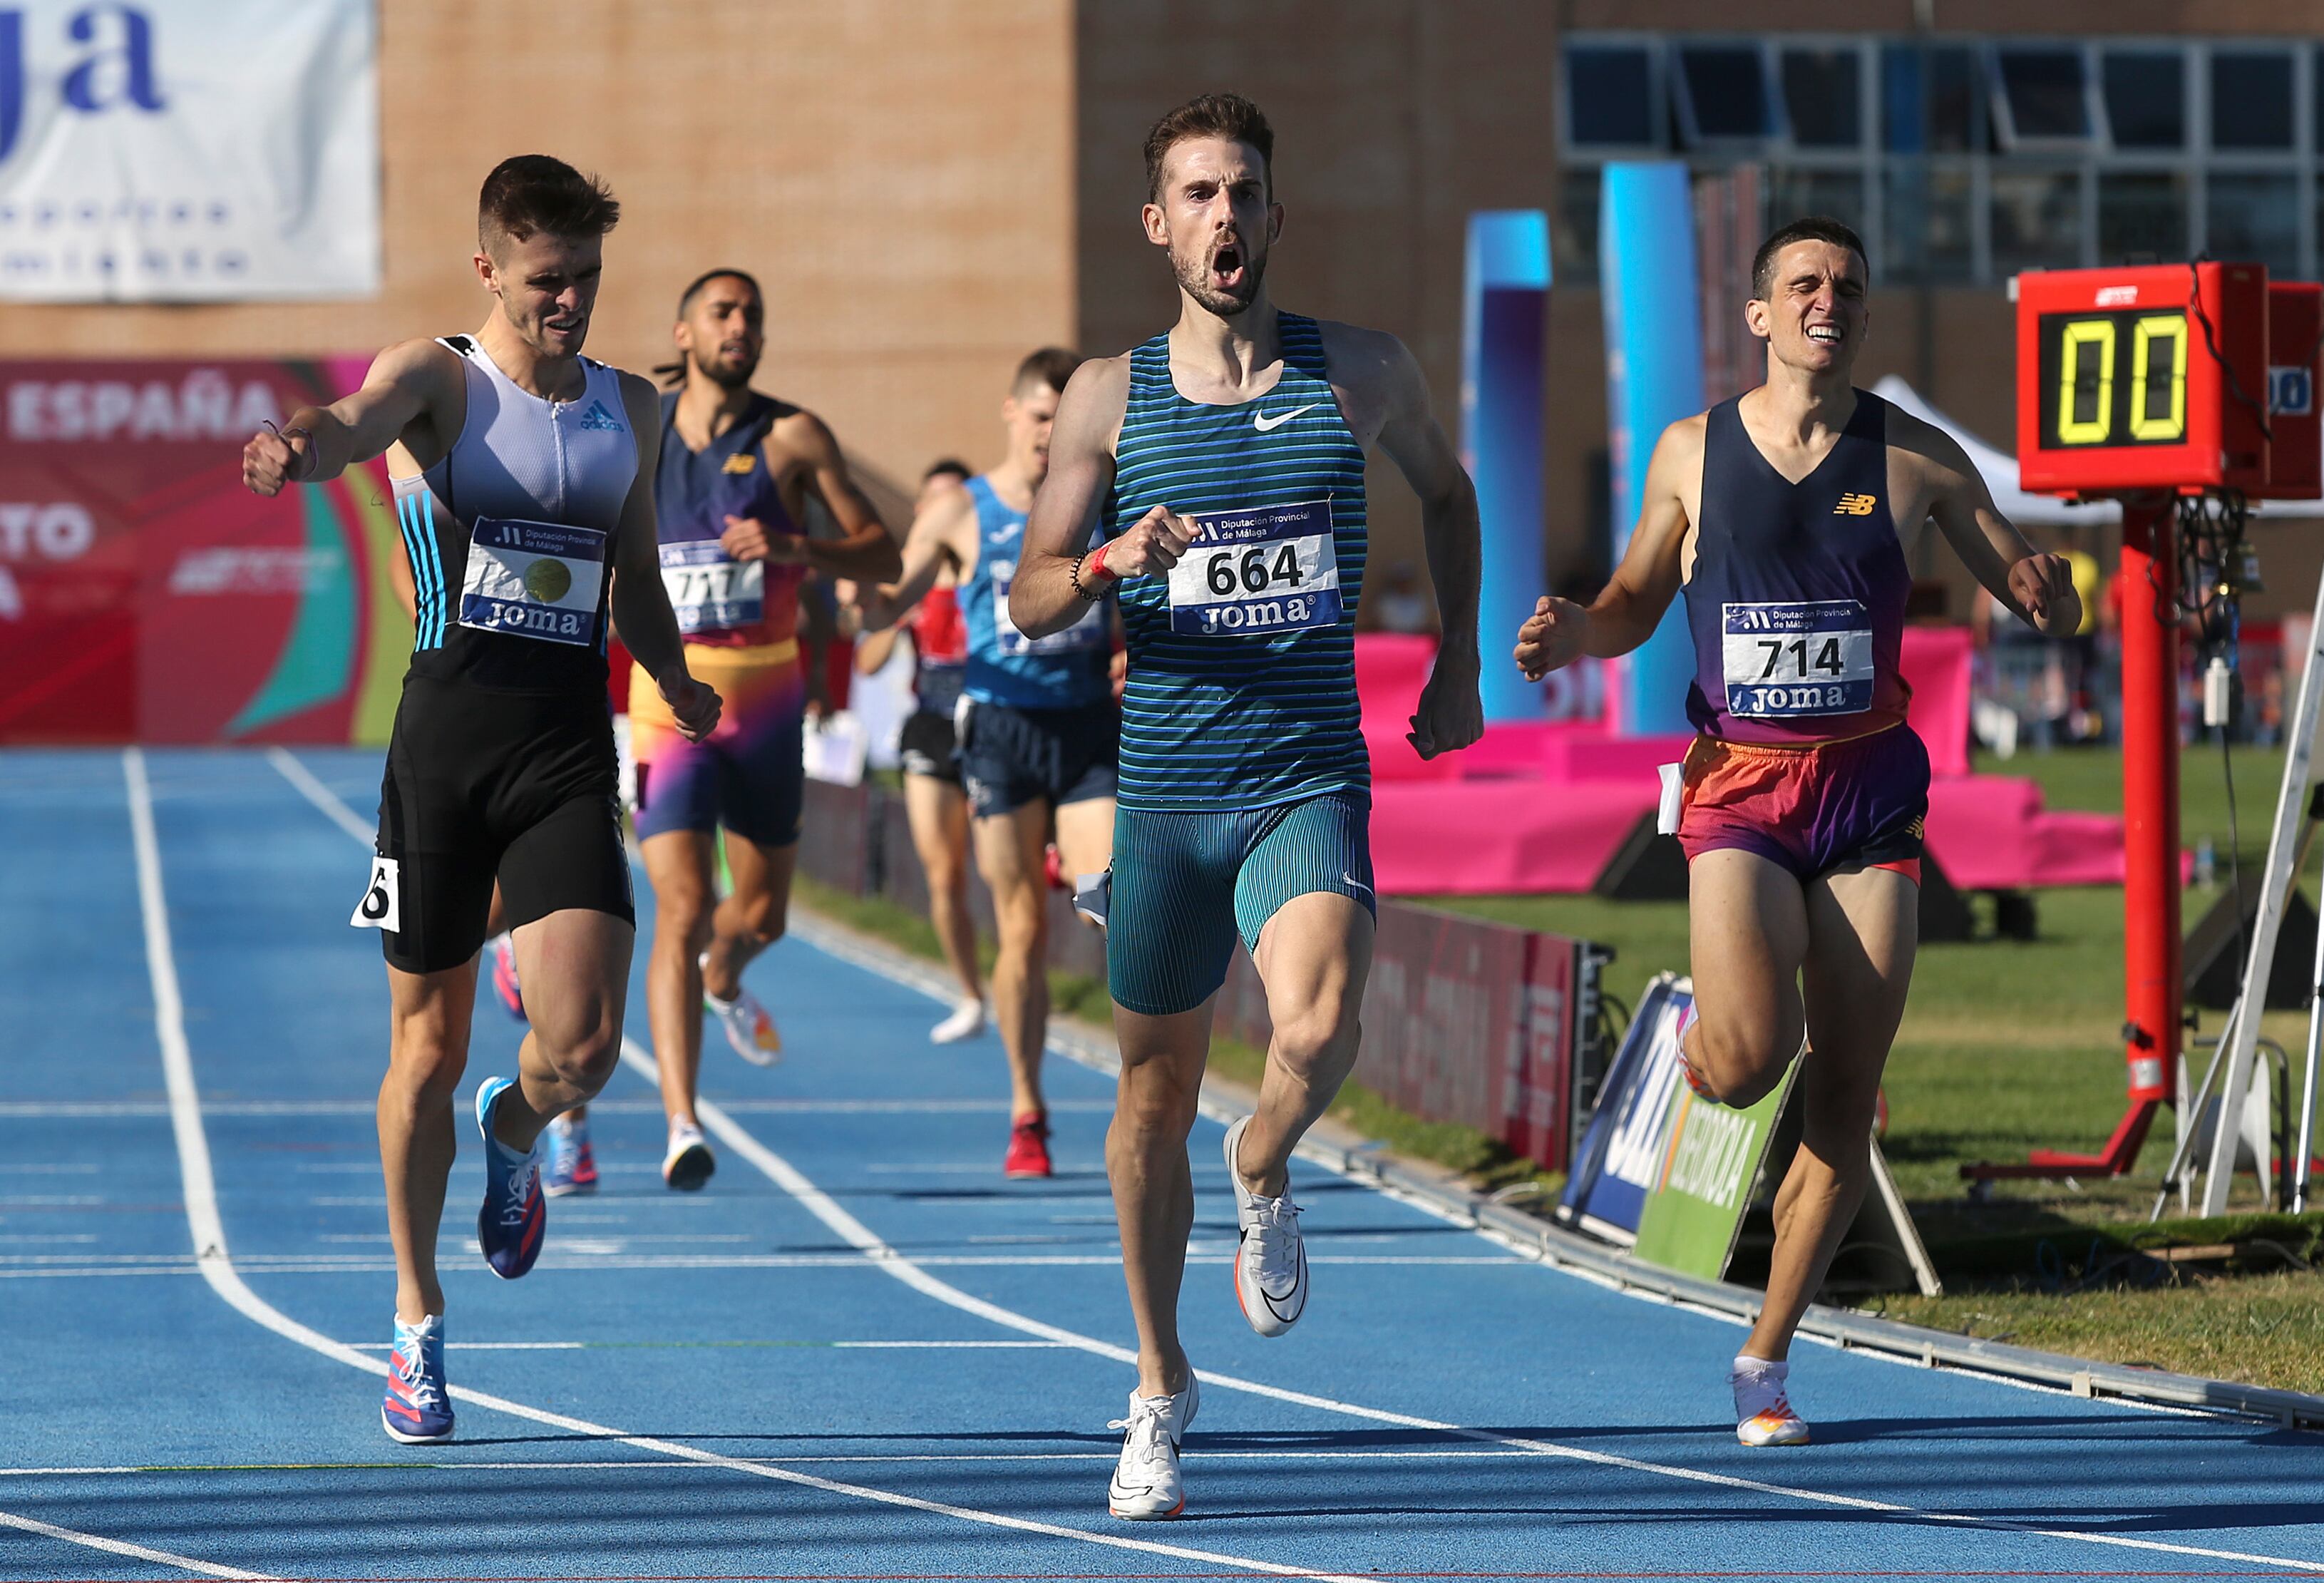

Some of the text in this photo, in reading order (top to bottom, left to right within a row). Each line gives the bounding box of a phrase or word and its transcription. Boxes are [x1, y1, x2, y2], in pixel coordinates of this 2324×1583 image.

[2058, 315, 2188, 444] 00
[9, 368, 284, 441] ESPAÑA
[1220, 511, 1310, 529] Diputación Provincial
[1222, 528, 1268, 540] de Málaga
[525, 529, 597, 545] Diputación Provincia
[525, 539, 564, 552] de Málaga
[677, 569, 735, 600] 717
[1207, 545, 1303, 595] 664
[1773, 608, 1853, 620] Diputación Provincial
[1785, 620, 1814, 629] Málaga
[1758, 638, 1844, 677] 714
[361, 867, 389, 920] 6
[1670, 1101, 1757, 1211] IBERDROLA
